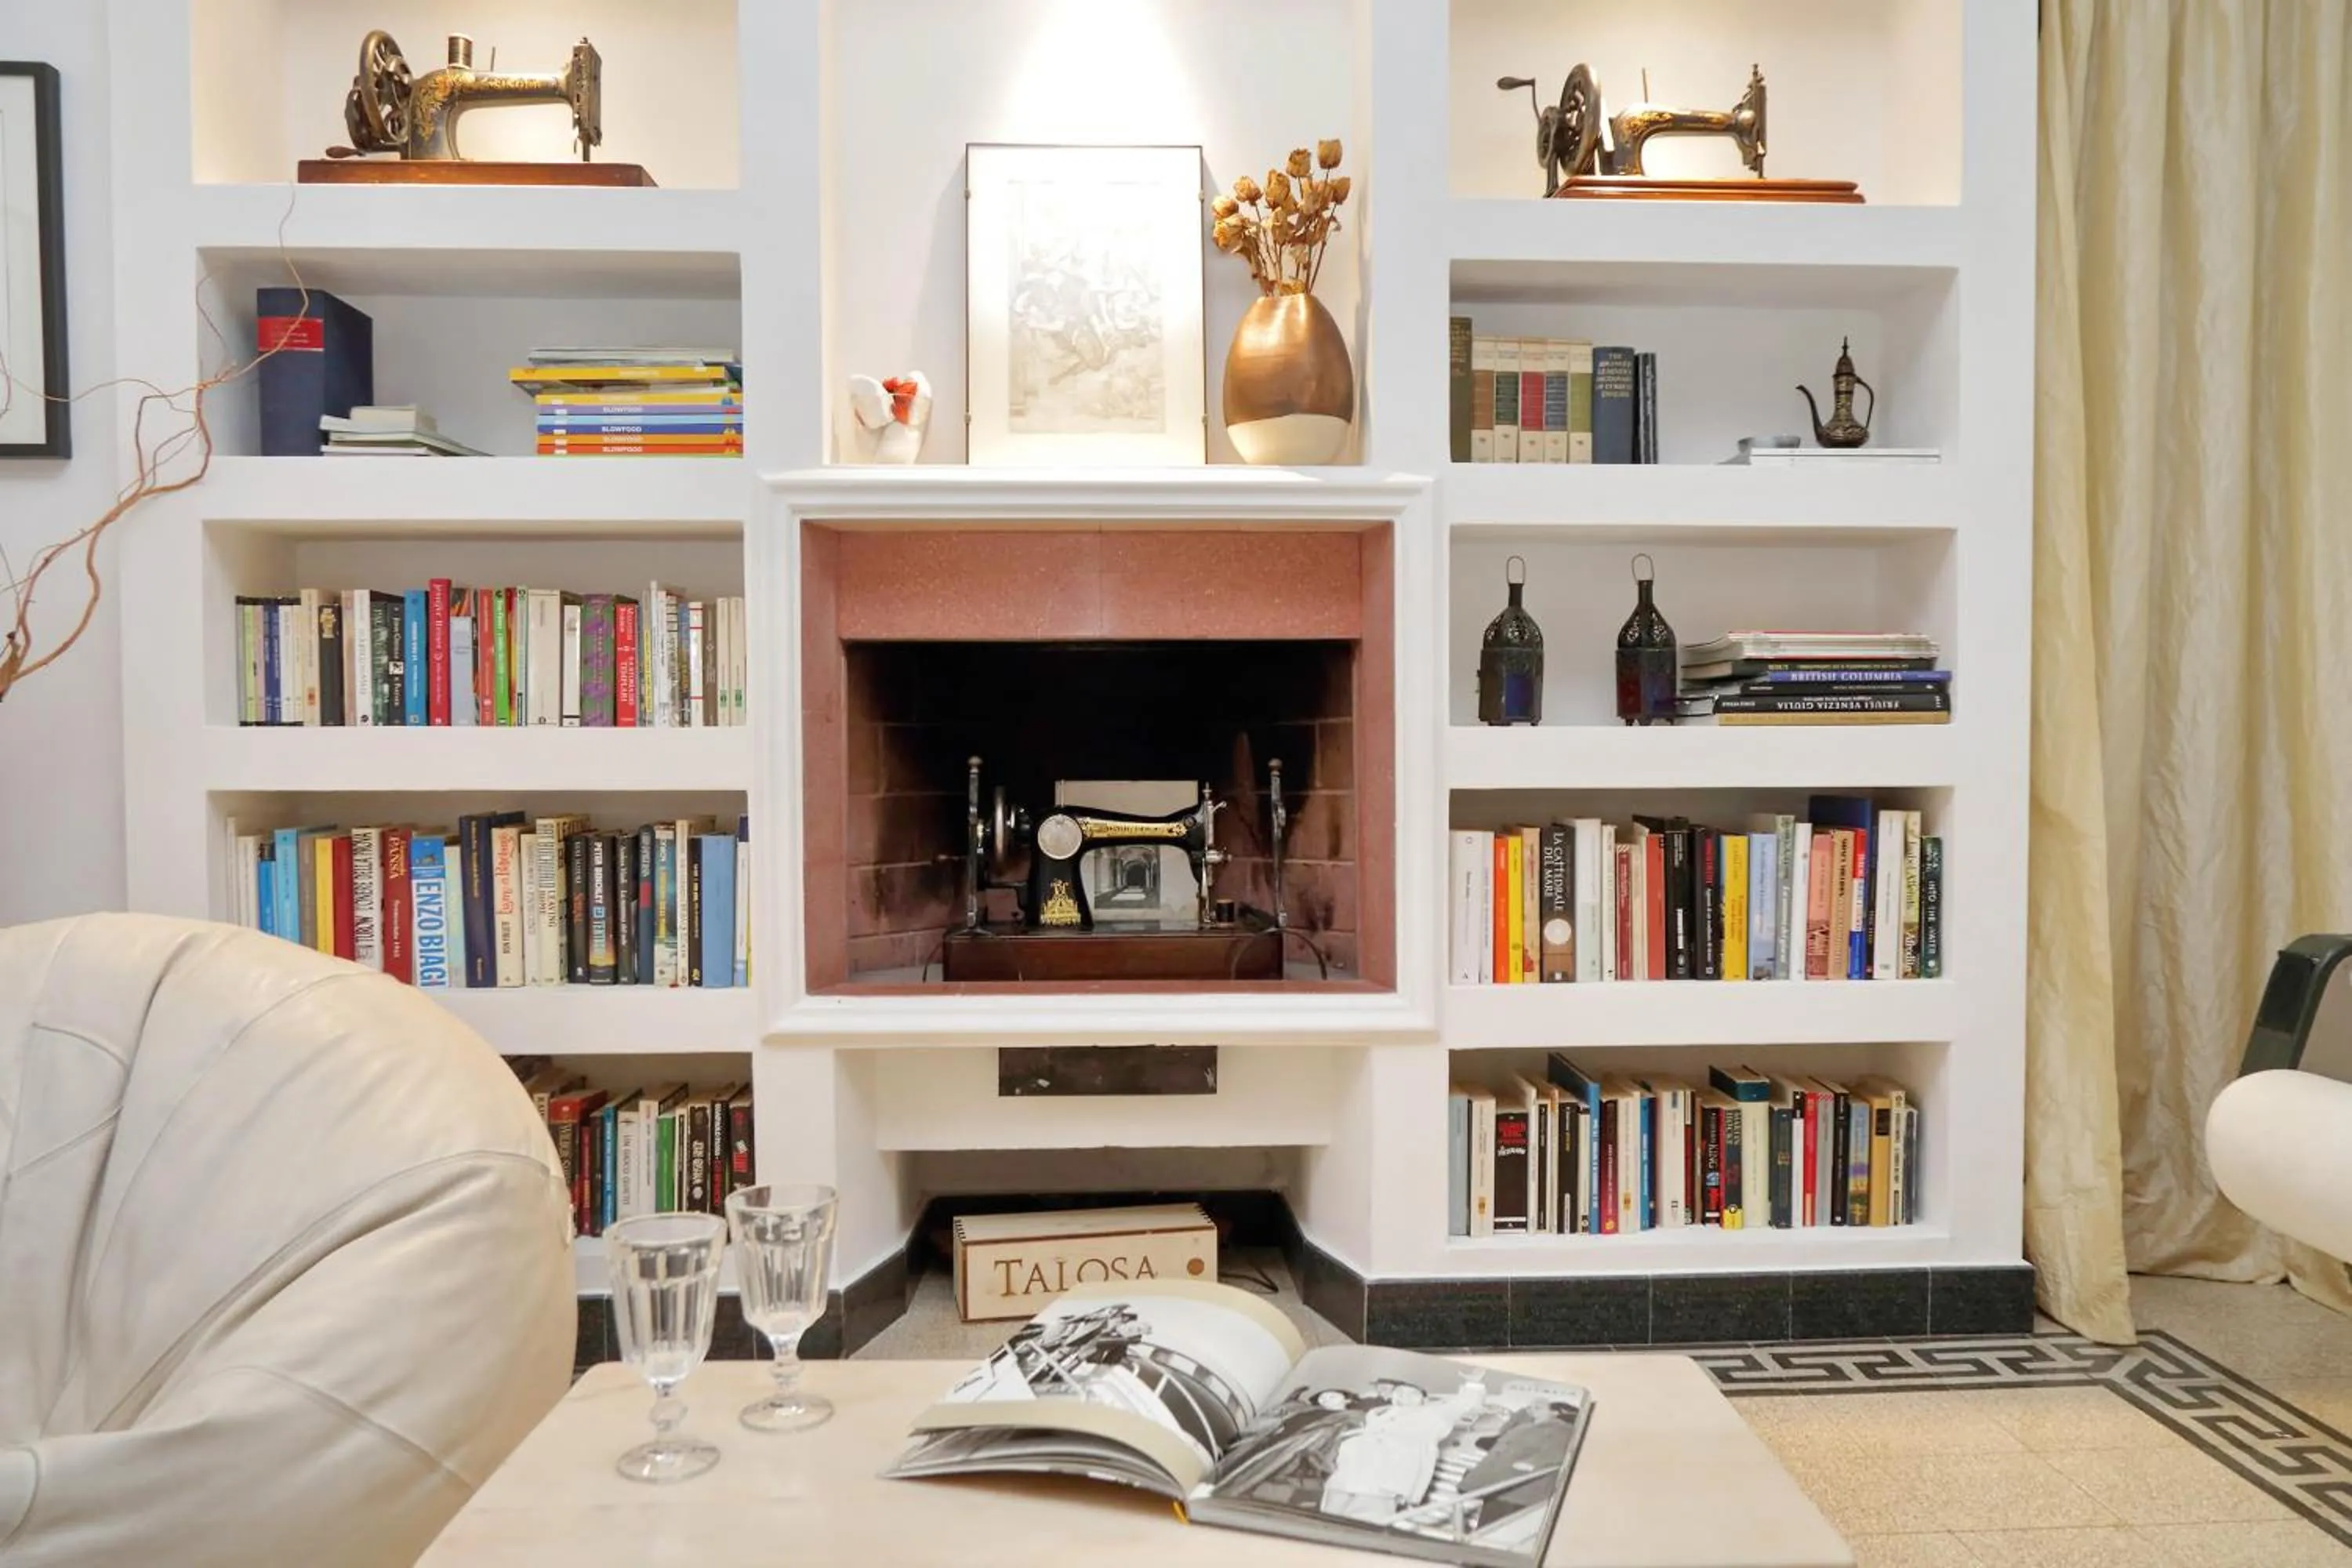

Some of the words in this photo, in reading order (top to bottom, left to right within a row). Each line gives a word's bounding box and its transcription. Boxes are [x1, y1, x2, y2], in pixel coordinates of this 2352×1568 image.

[1791, 672, 1837, 681] BRITISH
[1840, 672, 1903, 681] COLUMBIA
[1777, 701, 1814, 710] GIULIA
[1817, 701, 1861, 710] VENEZIA
[1864, 701, 1900, 710] FRIULI
[1553, 832, 1564, 844] LA
[389, 836, 401, 880] PANSA
[593, 841, 603, 866] PETER
[1544, 847, 1554, 866] DEL
[593, 866, 603, 904] BENCHLEY
[1544, 868, 1554, 897] MARE
[1554, 847, 1566, 911] CATTEDRALE
[1928, 880, 1936, 902] INTO
[416, 882, 445, 931] ENZO
[1928, 906, 1936, 922] THE
[1928, 927, 1936, 954] WATER
[419, 935, 447, 987] BIAGI
[1708, 1144, 1719, 1169] KING
